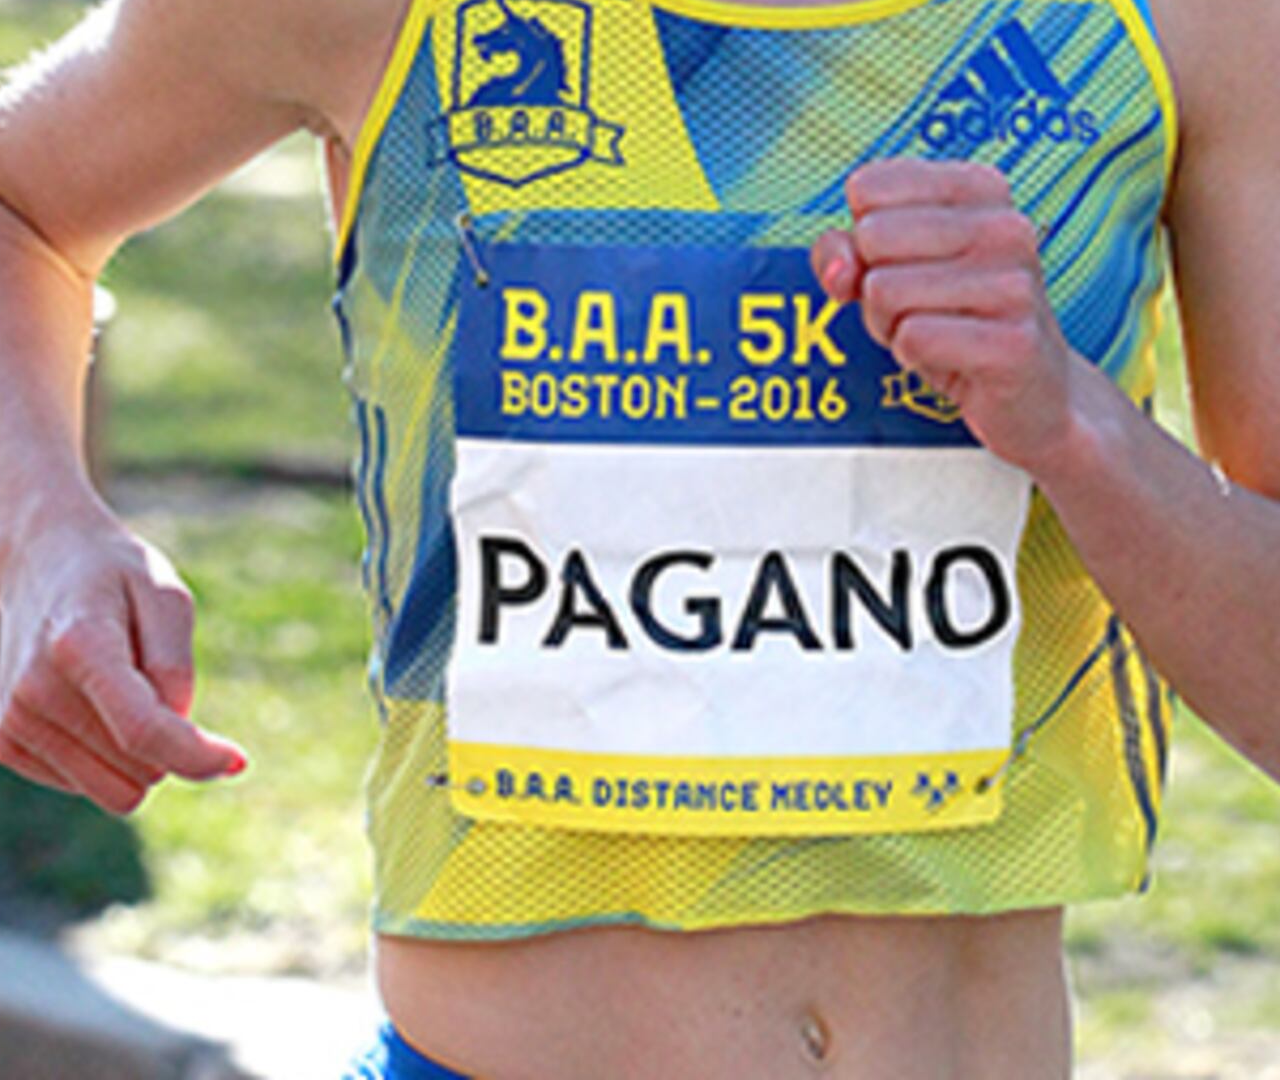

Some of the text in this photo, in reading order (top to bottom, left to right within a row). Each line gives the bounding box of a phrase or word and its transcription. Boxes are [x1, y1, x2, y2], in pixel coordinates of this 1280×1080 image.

[919, 92, 1102, 151] adidas
[500, 288, 847, 364] B.A.A. 5K
[477, 536, 1011, 653] PAGANO
[495, 767, 893, 813] B.A.A. DISTANCE MEDLEY
